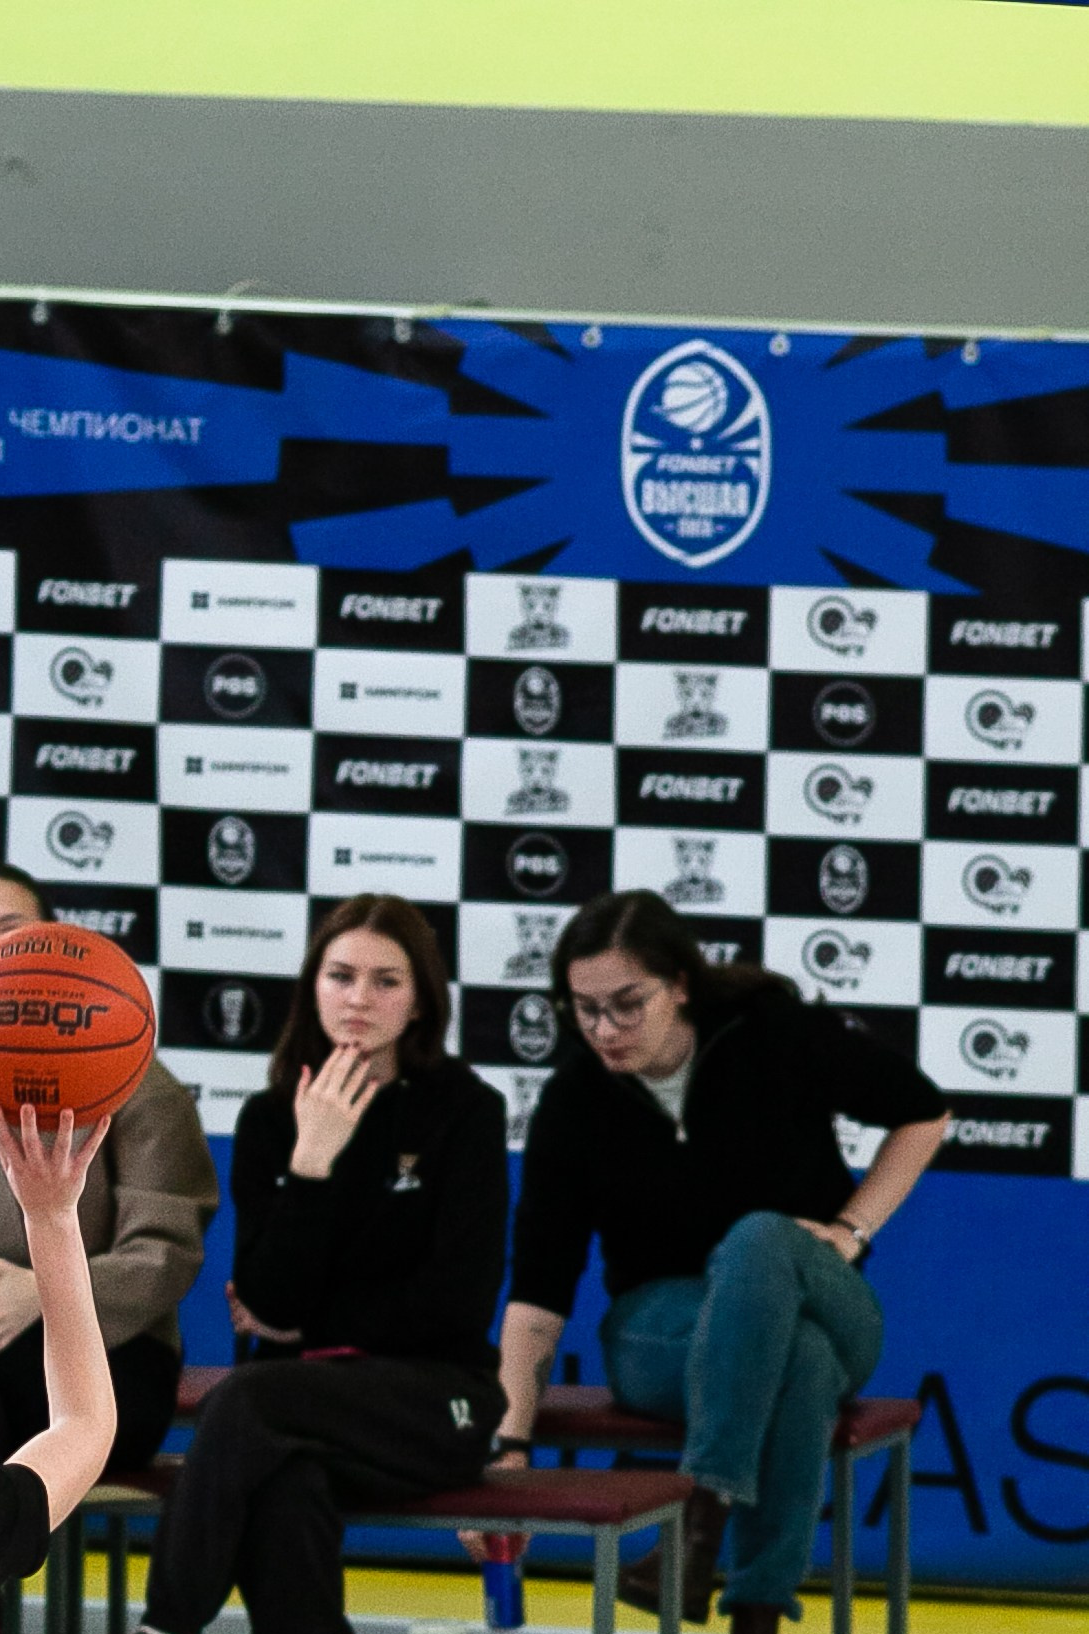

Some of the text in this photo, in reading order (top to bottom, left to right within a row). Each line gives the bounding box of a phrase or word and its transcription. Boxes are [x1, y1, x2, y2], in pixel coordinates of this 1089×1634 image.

[8, 408, 205, 444] ЧЕМПИОНАТ
[37, 578, 139, 608] FONBET
[340, 593, 444, 623] FONBET
[640, 607, 748, 636] FONBET
[950, 619, 1060, 649] FONBET
[35, 743, 137, 773] FONBET
[335, 759, 440, 789] FONBET
[639, 773, 745, 803] FONBET
[947, 787, 1056, 817] FONBET
[945, 952, 1054, 983] FONBET
[818, 1370, 1089, 1546] AS
